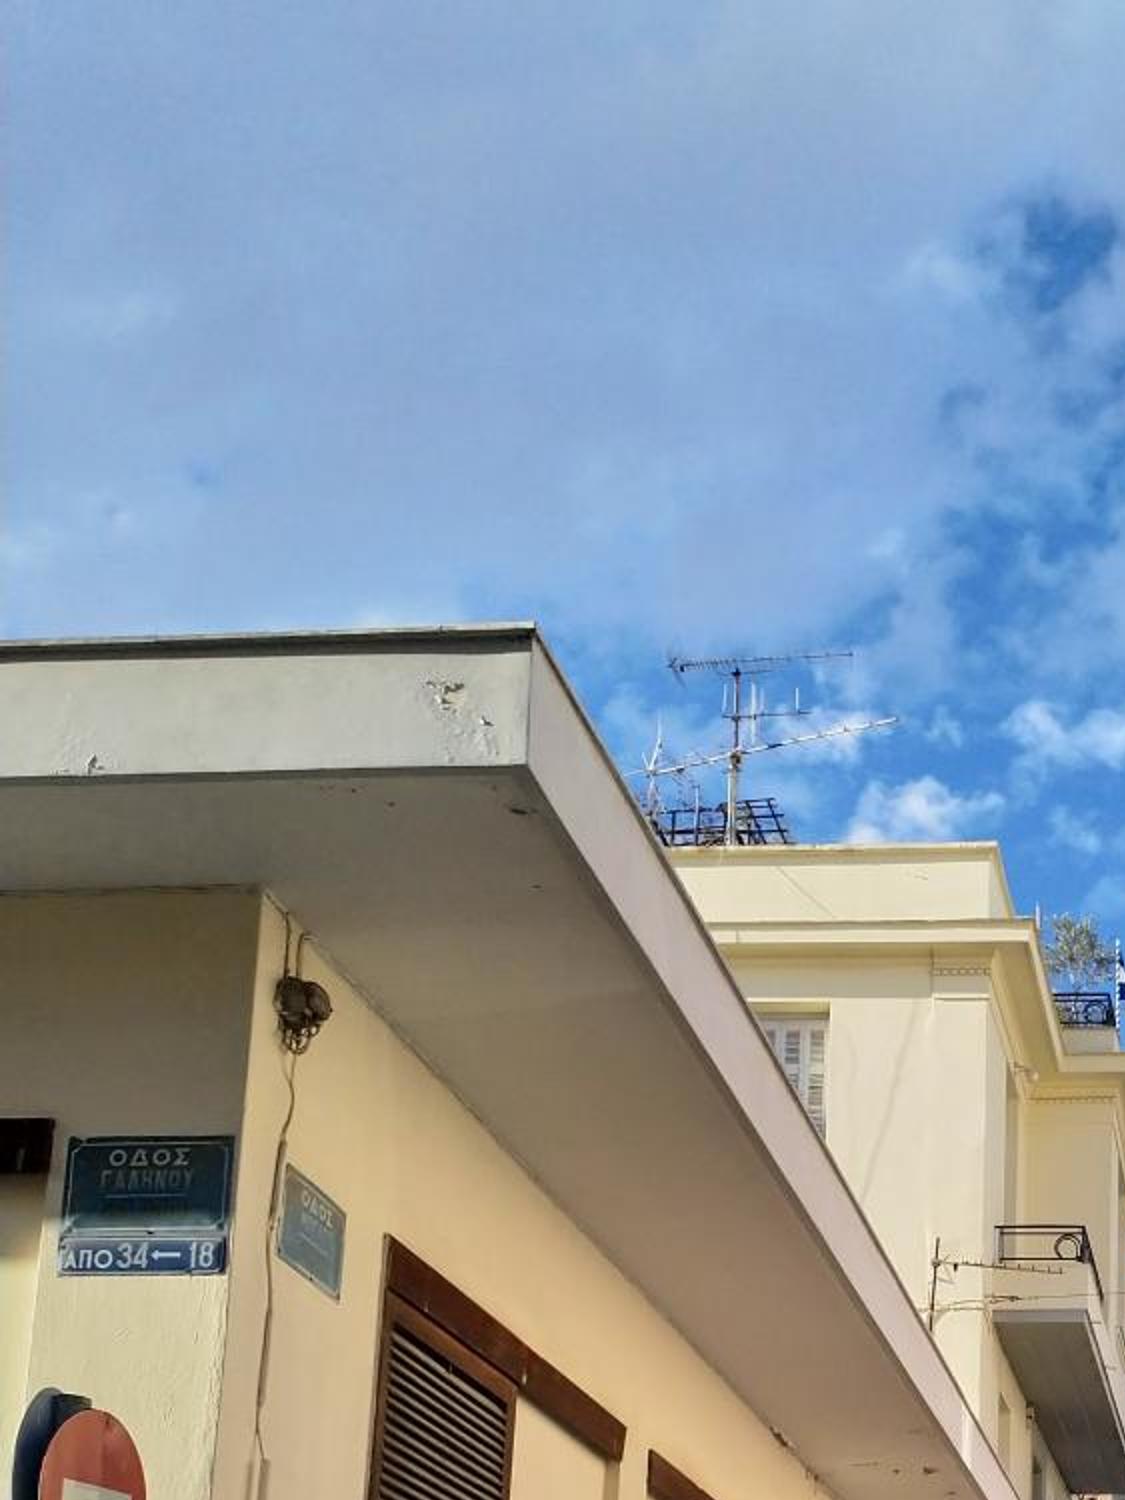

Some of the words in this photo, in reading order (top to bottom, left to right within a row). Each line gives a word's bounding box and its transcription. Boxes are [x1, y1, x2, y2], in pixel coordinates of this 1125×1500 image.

[109, 1148, 192, 1166] ΟΔΟΣ
[63, 1248, 113, 1269] ΑΠΟ
[116, 1242, 149, 1269] 34
[189, 1242, 215, 1268] 18
